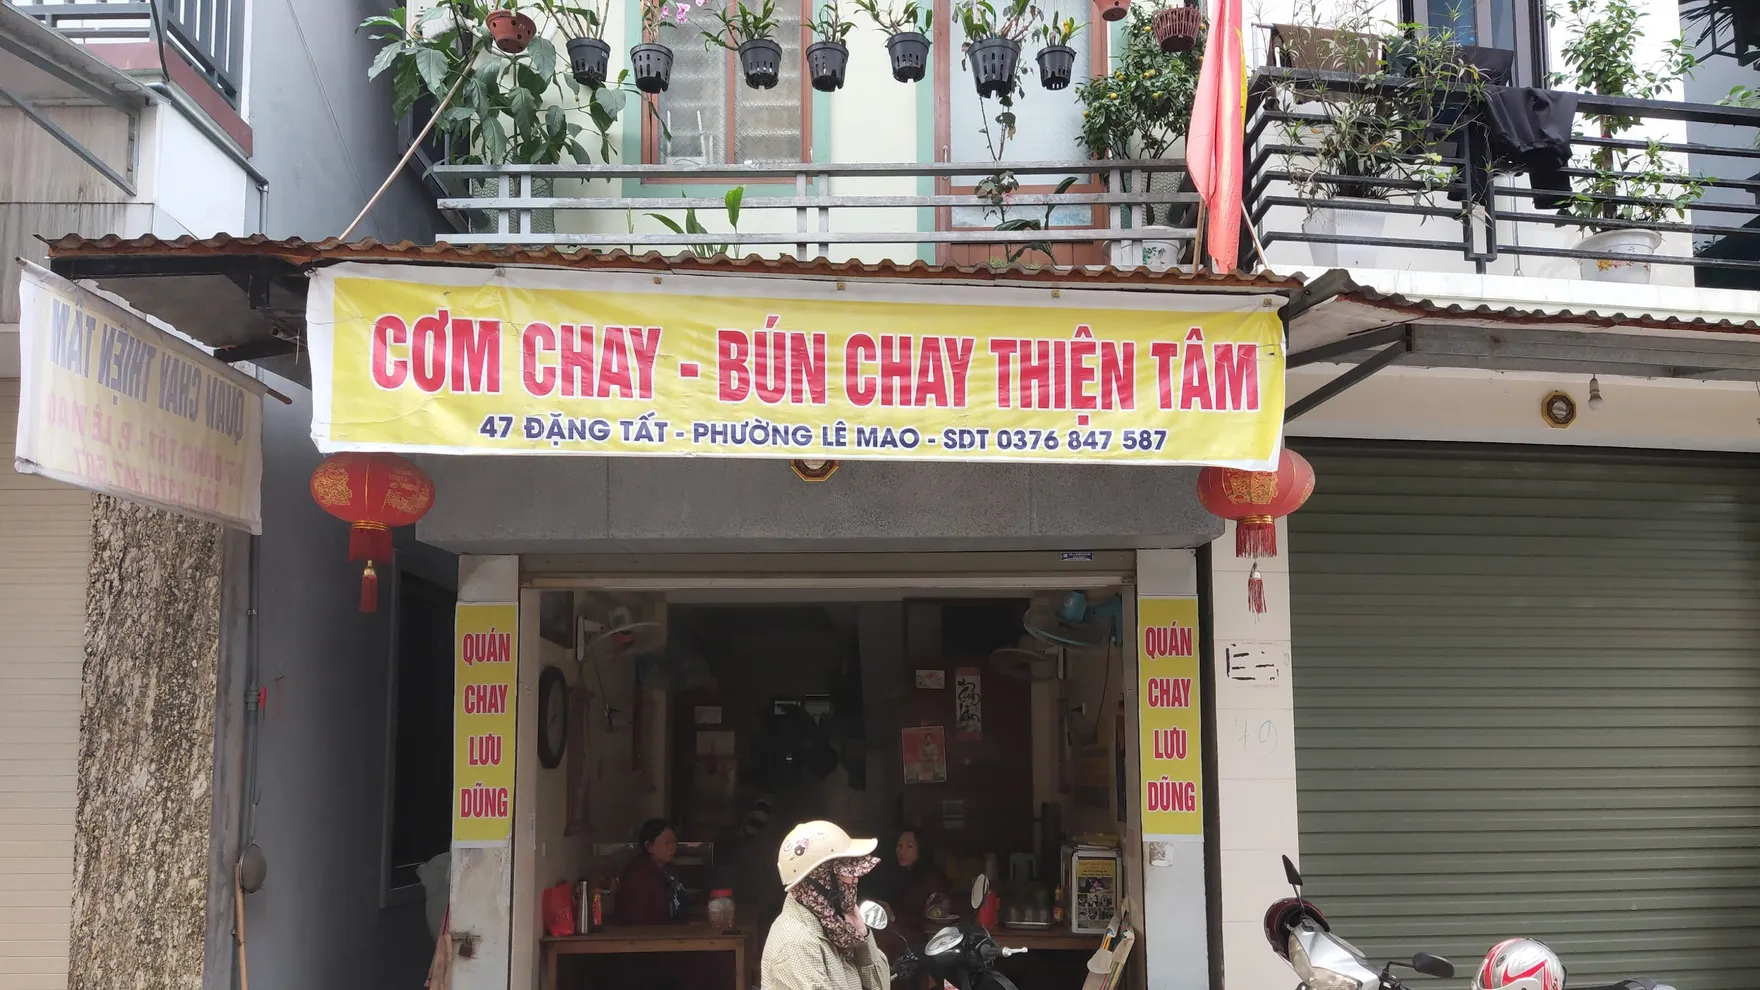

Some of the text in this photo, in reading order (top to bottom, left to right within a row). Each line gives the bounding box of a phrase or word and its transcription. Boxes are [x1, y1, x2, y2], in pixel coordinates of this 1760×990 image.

[371, 309, 1259, 426] CƠM CHAY - BÚN CHAY THIỆN TÂM
[480, 415, 513, 439] 47
[524, 412, 611, 446] ĐẶNG
[620, 411, 668, 443] TẤT
[692, 418, 813, 447] PHƯỜNG
[822, 421, 848, 447] LÊ
[856, 427, 920, 449] MAO
[943, 429, 989, 450] SDT
[997, 430, 1060, 450] 0376
[1068, 430, 1113, 450] 847
[1123, 430, 1167, 450] 587
[463, 627, 511, 665] QUÁN
[1145, 621, 1193, 659] QUÁN
[464, 684, 508, 714] CHAY
[1148, 678, 1191, 707] CHAY
[469, 733, 502, 765] LƯU
[1154, 727, 1187, 759] LƯU
[461, 783, 508, 818] DŨNG
[1148, 776, 1196, 811] DŨNG
